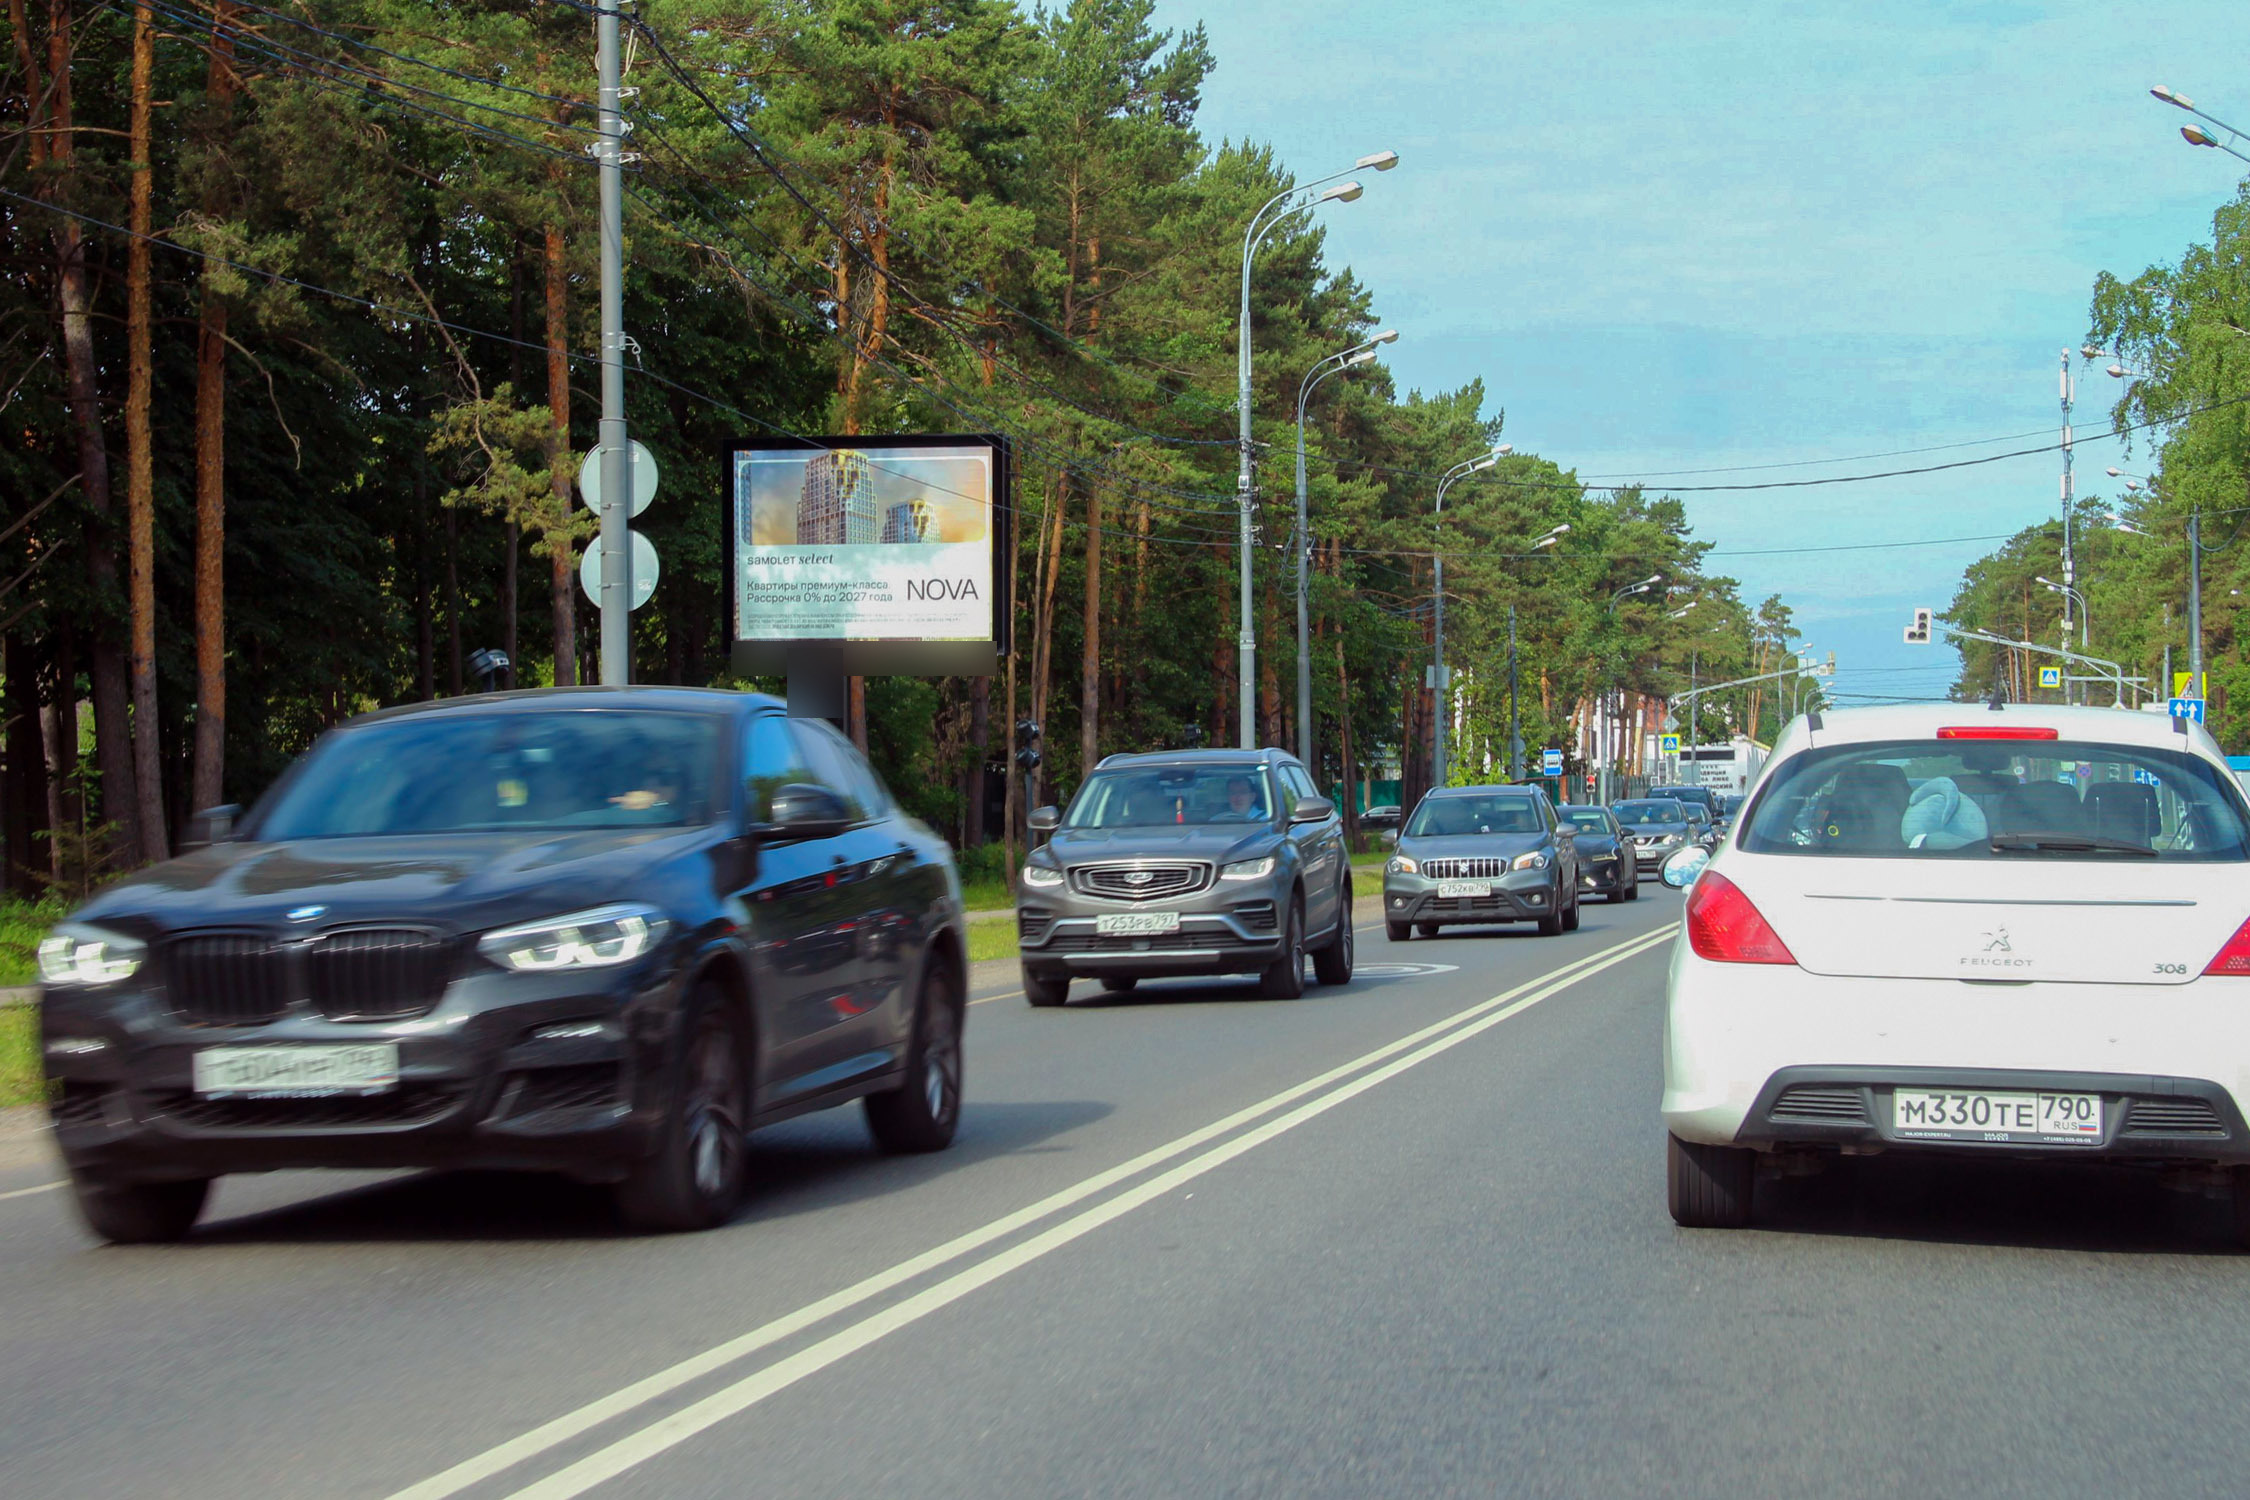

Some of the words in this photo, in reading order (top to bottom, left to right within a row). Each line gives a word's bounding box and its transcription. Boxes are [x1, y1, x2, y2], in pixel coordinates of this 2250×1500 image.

[799, 553, 834, 566] select
[747, 581, 798, 594] Квартиры
[801, 581, 889, 594] премиум-класса
[907, 578, 979, 601] NOVA
[747, 593, 801, 604] Рассрочка
[804, 592, 821, 602] 0%
[823, 594, 837, 604] до
[839, 591, 867, 602] 2027
[869, 592, 894, 603] года
[1960, 957, 2033, 967] PEUGEOT
[2152, 963, 2187, 975] 308
[1905, 1094, 2034, 1128] М330ТЕ
[2041, 1095, 2092, 1121] 790
[2053, 1120, 2079, 1131] RUS
